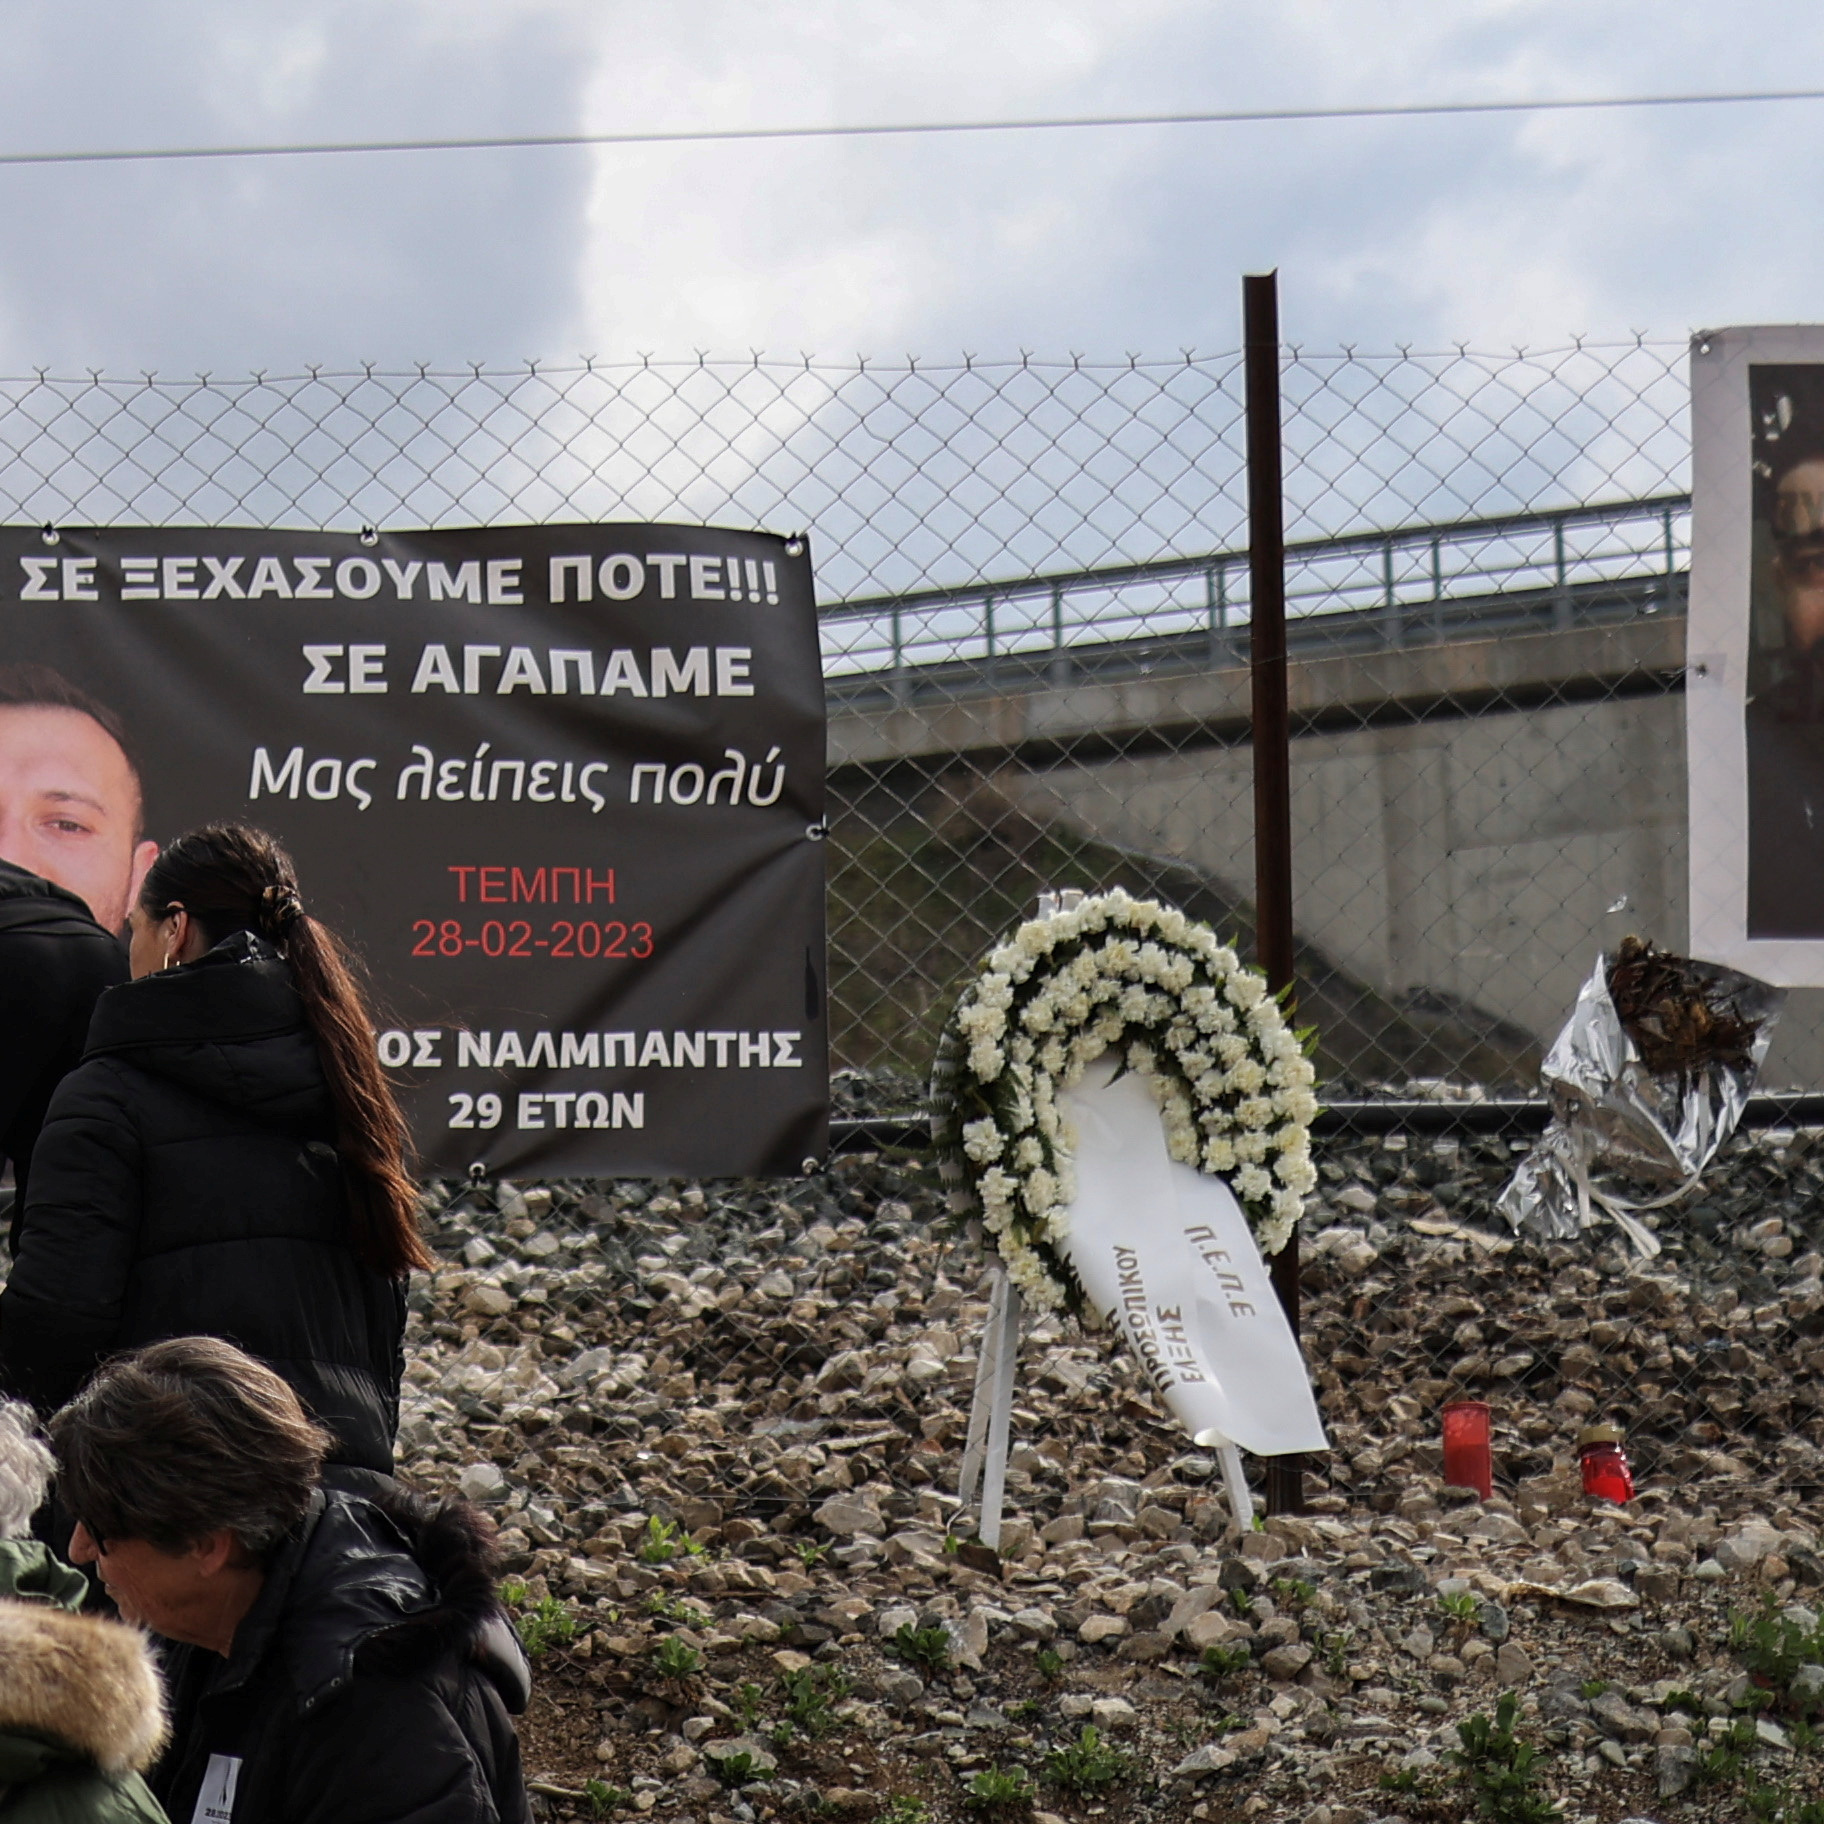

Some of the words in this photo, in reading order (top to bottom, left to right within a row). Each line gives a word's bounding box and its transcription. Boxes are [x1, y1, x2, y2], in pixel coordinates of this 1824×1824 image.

[19, 557, 99, 601] ΣΕ
[120, 556, 524, 605] ΞΕΧΑΣΟΥΜΕ
[550, 553, 780, 606] ΠΟΤΕ!!!
[302, 644, 389, 694] ΣΕ
[411, 644, 755, 698] ΑΓΑΠΑΜΕ
[249, 746, 377, 811] Μας
[396, 742, 609, 813] λείπεις
[630, 746, 786, 807] πολύ
[448, 866, 615, 904] ΤΕΜΠΗ
[411, 919, 654, 959] 28-02-2023
[458, 1030, 802, 1069] ΝΑΛΜΠΑΝΤΗΣ
[448, 1093, 503, 1129] 29
[517, 1092, 645, 1130] ΕΤΩΝ
